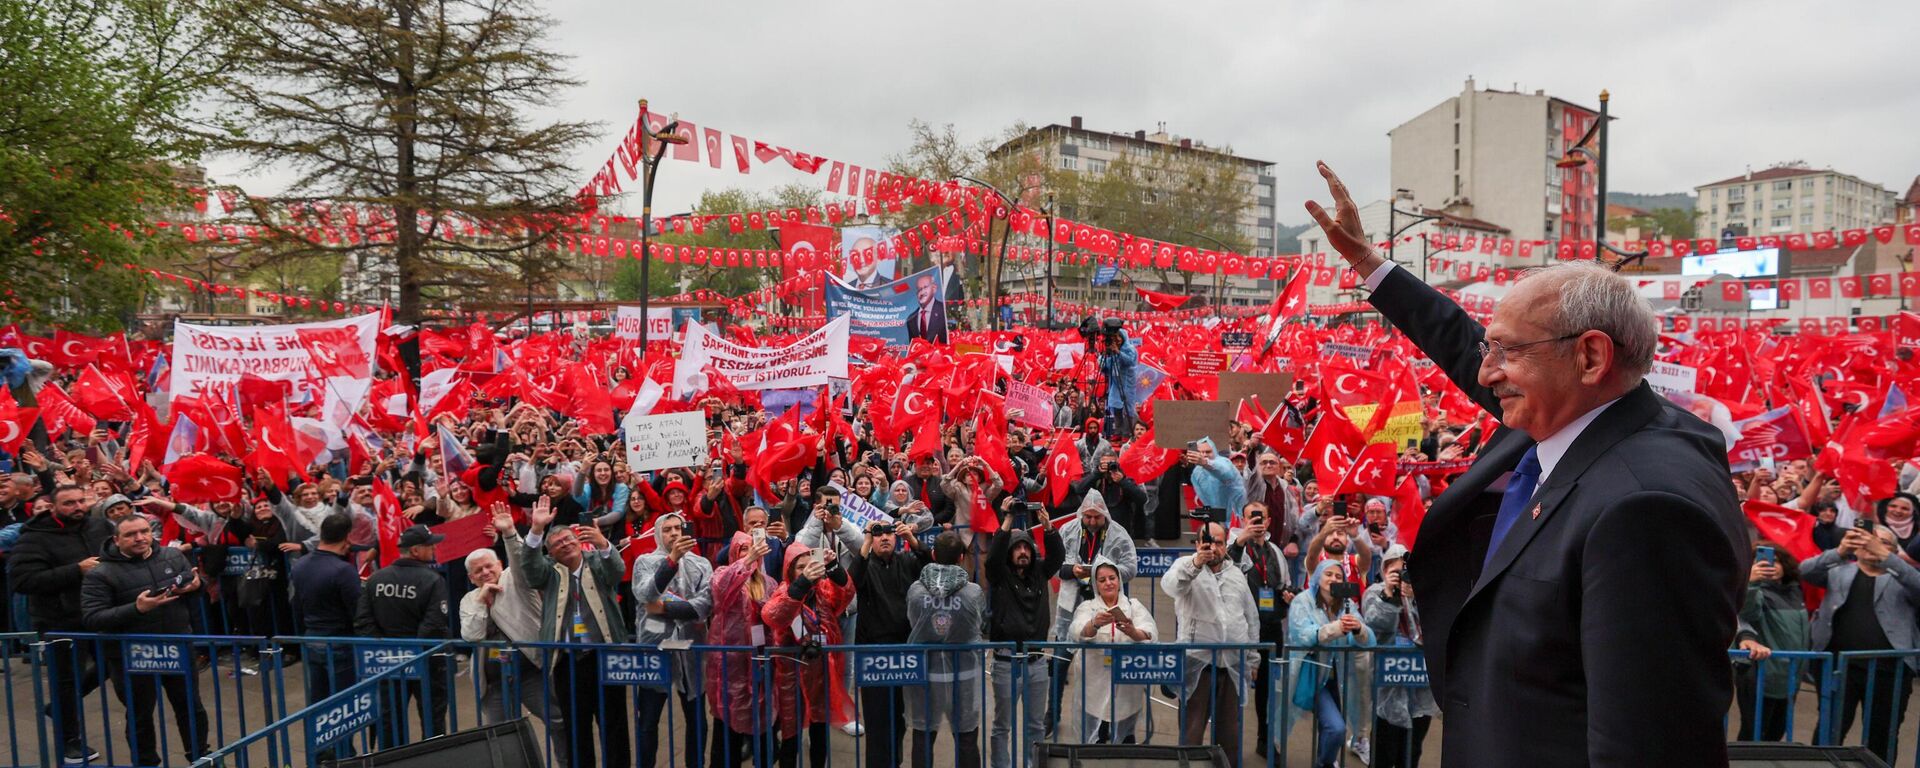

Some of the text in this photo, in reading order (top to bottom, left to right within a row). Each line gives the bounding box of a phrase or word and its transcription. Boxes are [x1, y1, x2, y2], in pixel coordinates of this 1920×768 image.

[607, 652, 661, 670] POLİS
[862, 652, 918, 671] POLİS
[1121, 651, 1177, 669] POLİS
[1384, 657, 1427, 671] POL
[1384, 673, 1429, 683] KUTAH
[315, 693, 372, 733] POLİS
